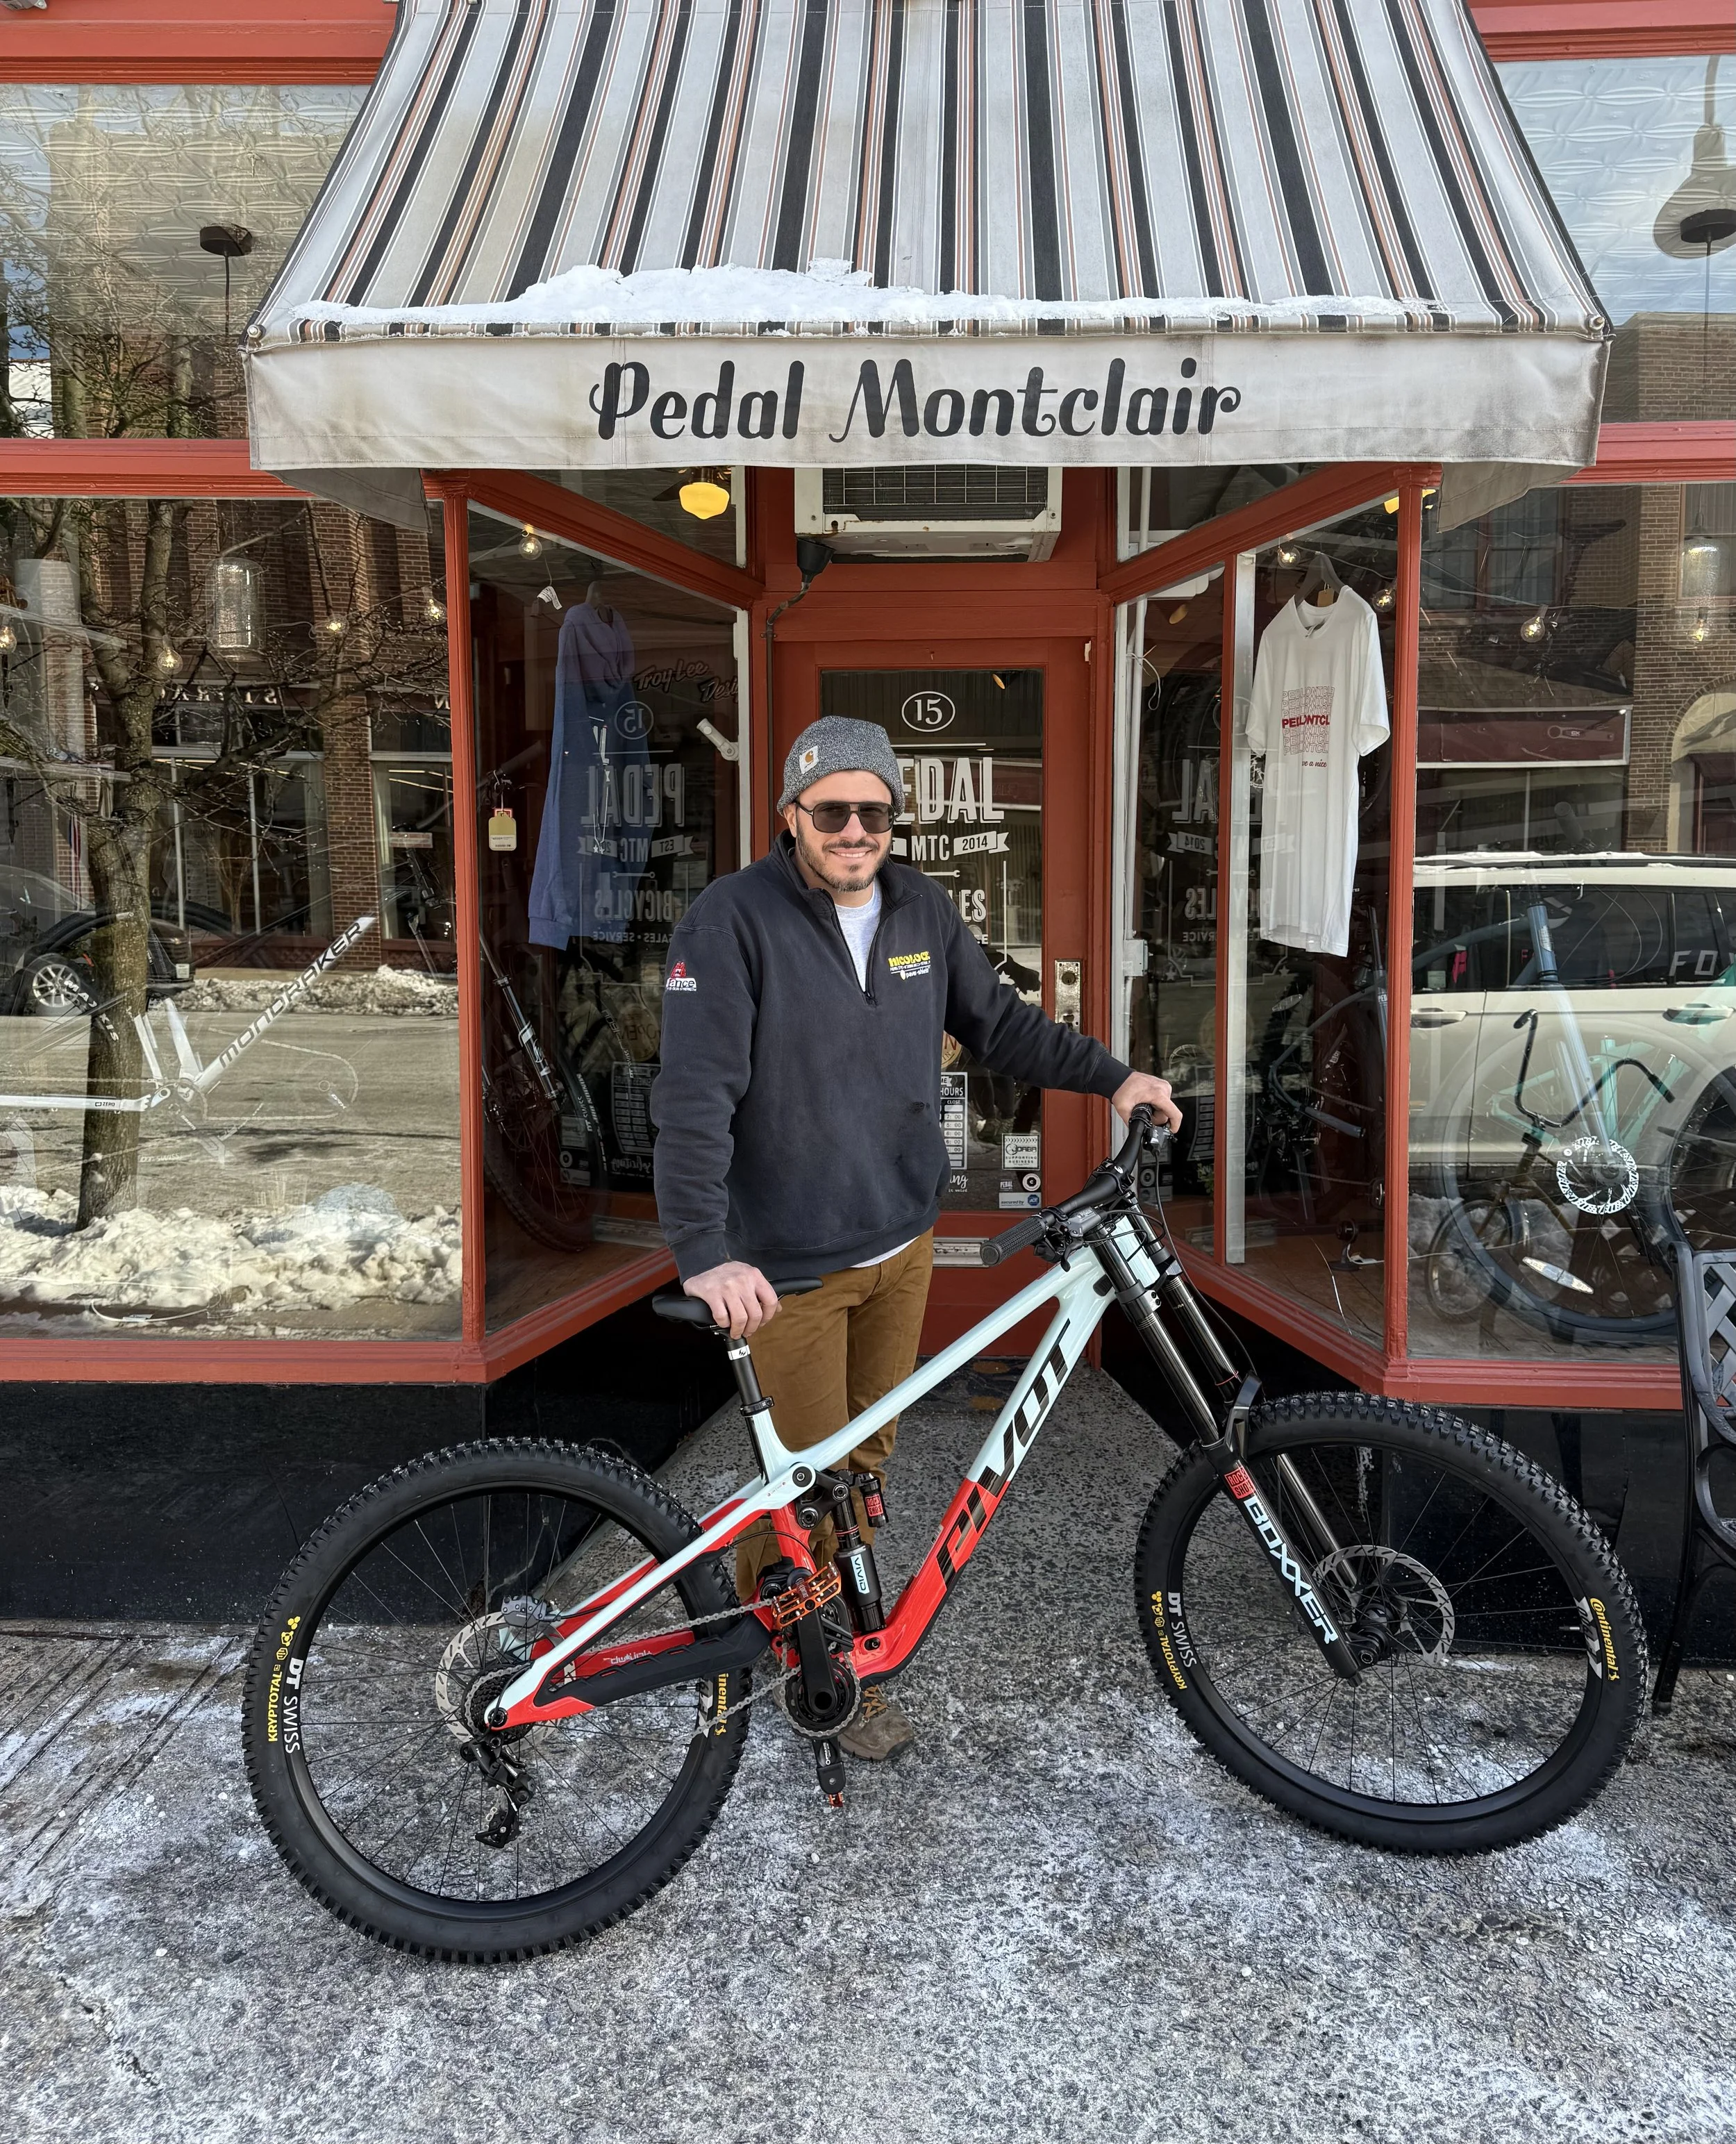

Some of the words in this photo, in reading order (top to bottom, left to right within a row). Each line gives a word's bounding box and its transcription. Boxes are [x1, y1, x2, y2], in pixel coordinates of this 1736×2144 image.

[590, 359, 804, 440] Pedal
[828, 357, 1241, 443] Montclair
[633, 665, 672, 693] Troy
[674, 659, 709, 682] Lee
[914, 698, 943, 725] 15
[893, 757, 1005, 825] EDAL
[910, 834, 950, 861] MTC
[962, 835, 988, 851] 2014
[940, 1087, 964, 1096] HOURS
[937, 1318, 1071, 1591] PIVOT
[853, 1557, 867, 1591] VIVID
[1243, 1495, 1338, 1645] BOXXER
[1168, 1591, 1183, 1617] DT
[1171, 1621, 1197, 1668] SWISS
[1589, 1597, 1619, 1671] Continental
[285, 1657, 304, 1690] DT
[1160, 1634, 1188, 1690] KRYPTOTAL
[268, 1671, 283, 1742] KRYPTOTAL
[717, 1672, 729, 1724] inental
[283, 1696, 300, 1754] SWISS
